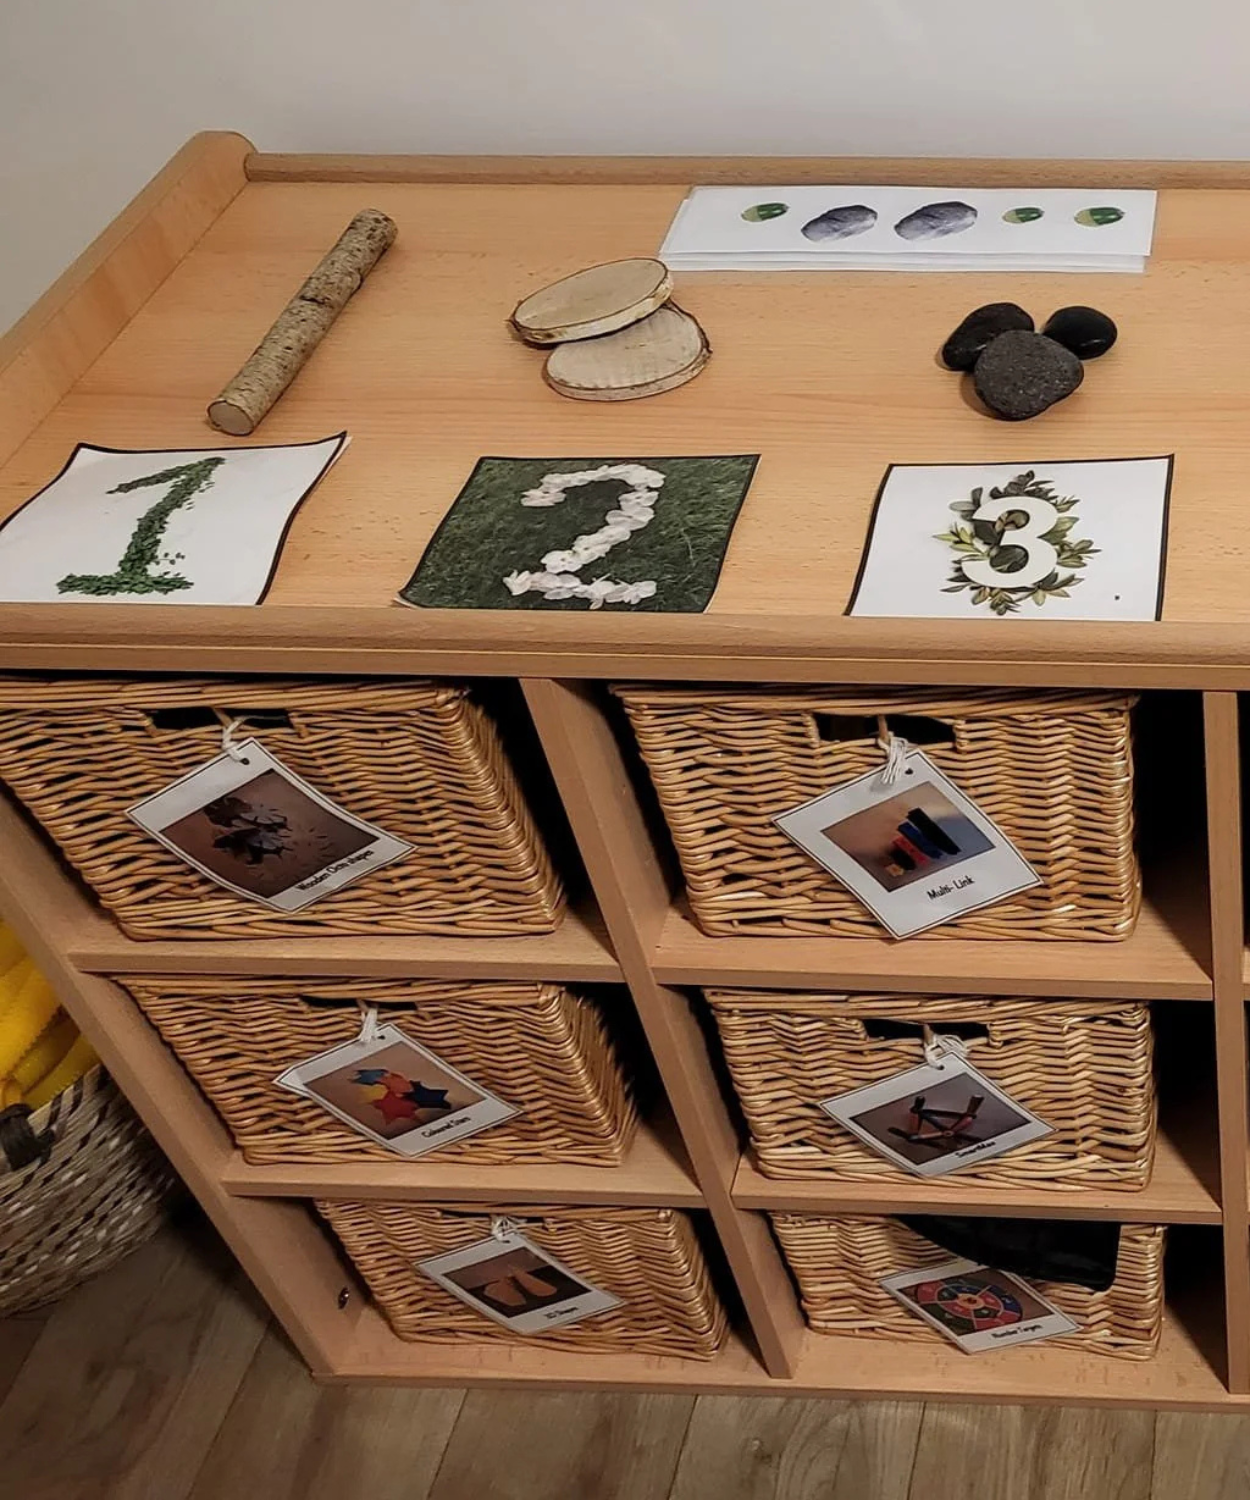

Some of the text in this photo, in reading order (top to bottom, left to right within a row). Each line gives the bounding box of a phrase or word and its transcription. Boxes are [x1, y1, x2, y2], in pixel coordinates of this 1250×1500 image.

[57, 455, 226, 597] 1
[503, 463, 665, 610] 2
[962, 495, 1061, 590] 3
[953, 875, 976, 891] Link
